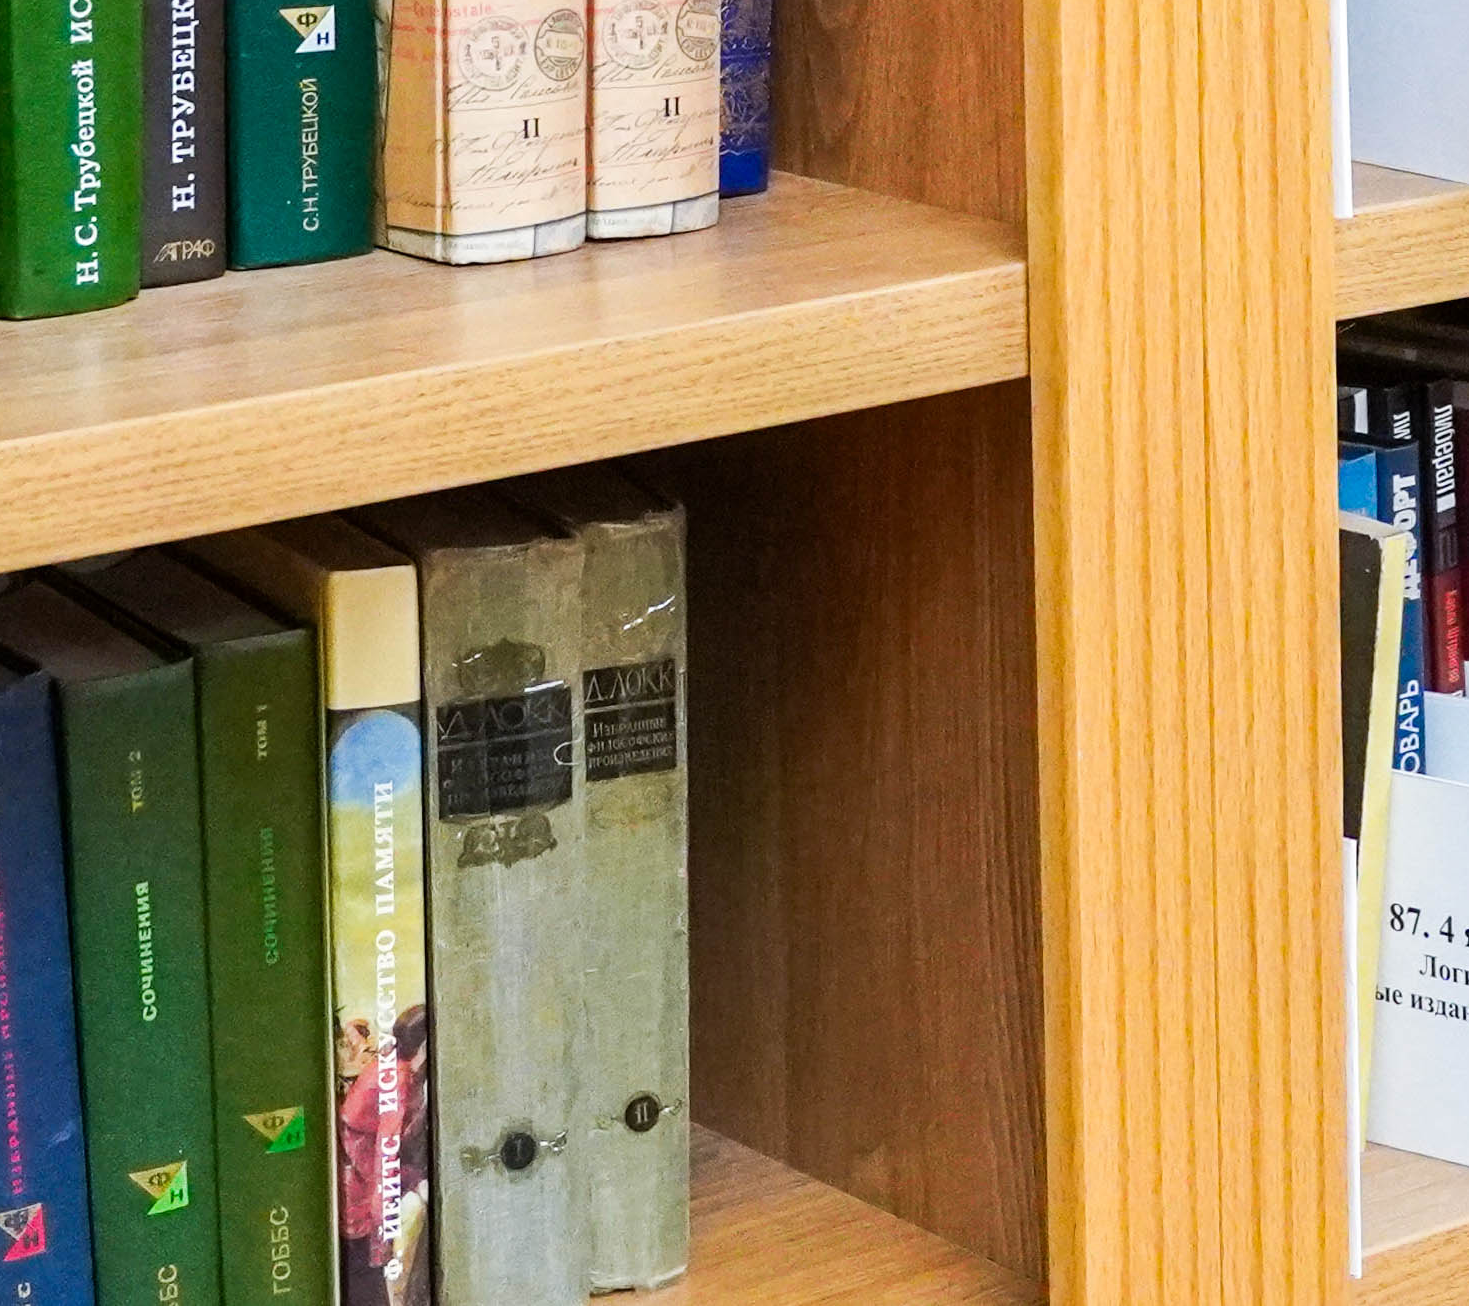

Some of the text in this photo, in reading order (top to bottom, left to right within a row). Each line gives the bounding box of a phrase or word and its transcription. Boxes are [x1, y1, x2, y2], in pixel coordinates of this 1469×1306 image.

[71, 56, 99, 210] Трубецкой
[1436, 402, 1455, 493] либерал
[586, 666, 675, 705] Д.ЛОКК
[136, 880, 158, 1022] СОЧИНЕНИЯ
[259, 827, 279, 965] СОЧИНЕНИЯ
[1389, 903, 1430, 939] 87.
[1439, 916, 1455, 943] 4
[372, 780, 403, 1240] ЙЕЙТС ИСКУССТВО ПАМЯТИ
[273, 1204, 290, 1296] ГОББС
